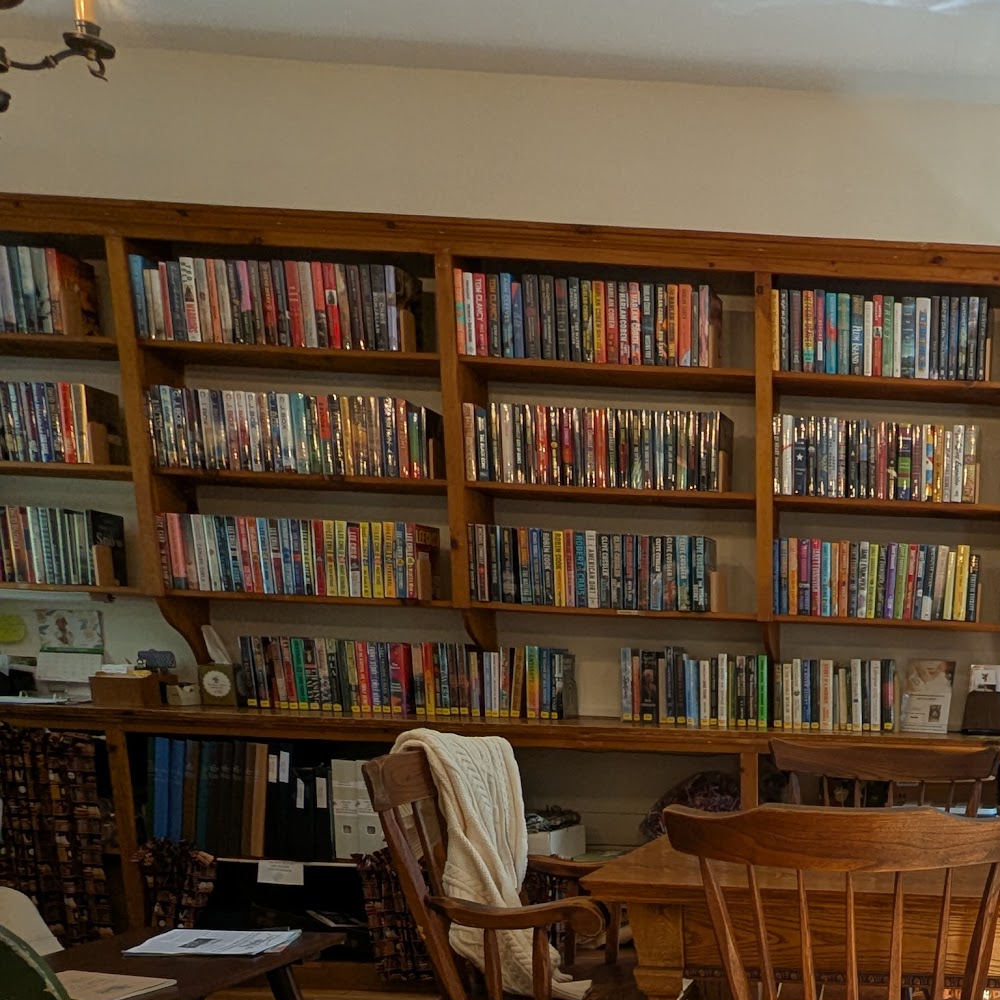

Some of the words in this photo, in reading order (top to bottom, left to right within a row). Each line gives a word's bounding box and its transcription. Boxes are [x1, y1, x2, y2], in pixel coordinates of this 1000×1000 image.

[186, 303, 198, 333] WARRIORS
[490, 295, 498, 321] CLANCY
[631, 322, 639, 344] COBEN
[852, 326, 862, 340] PLUM
[852, 343, 862, 364] ISLAND
[575, 535, 584, 566] ROBERT
